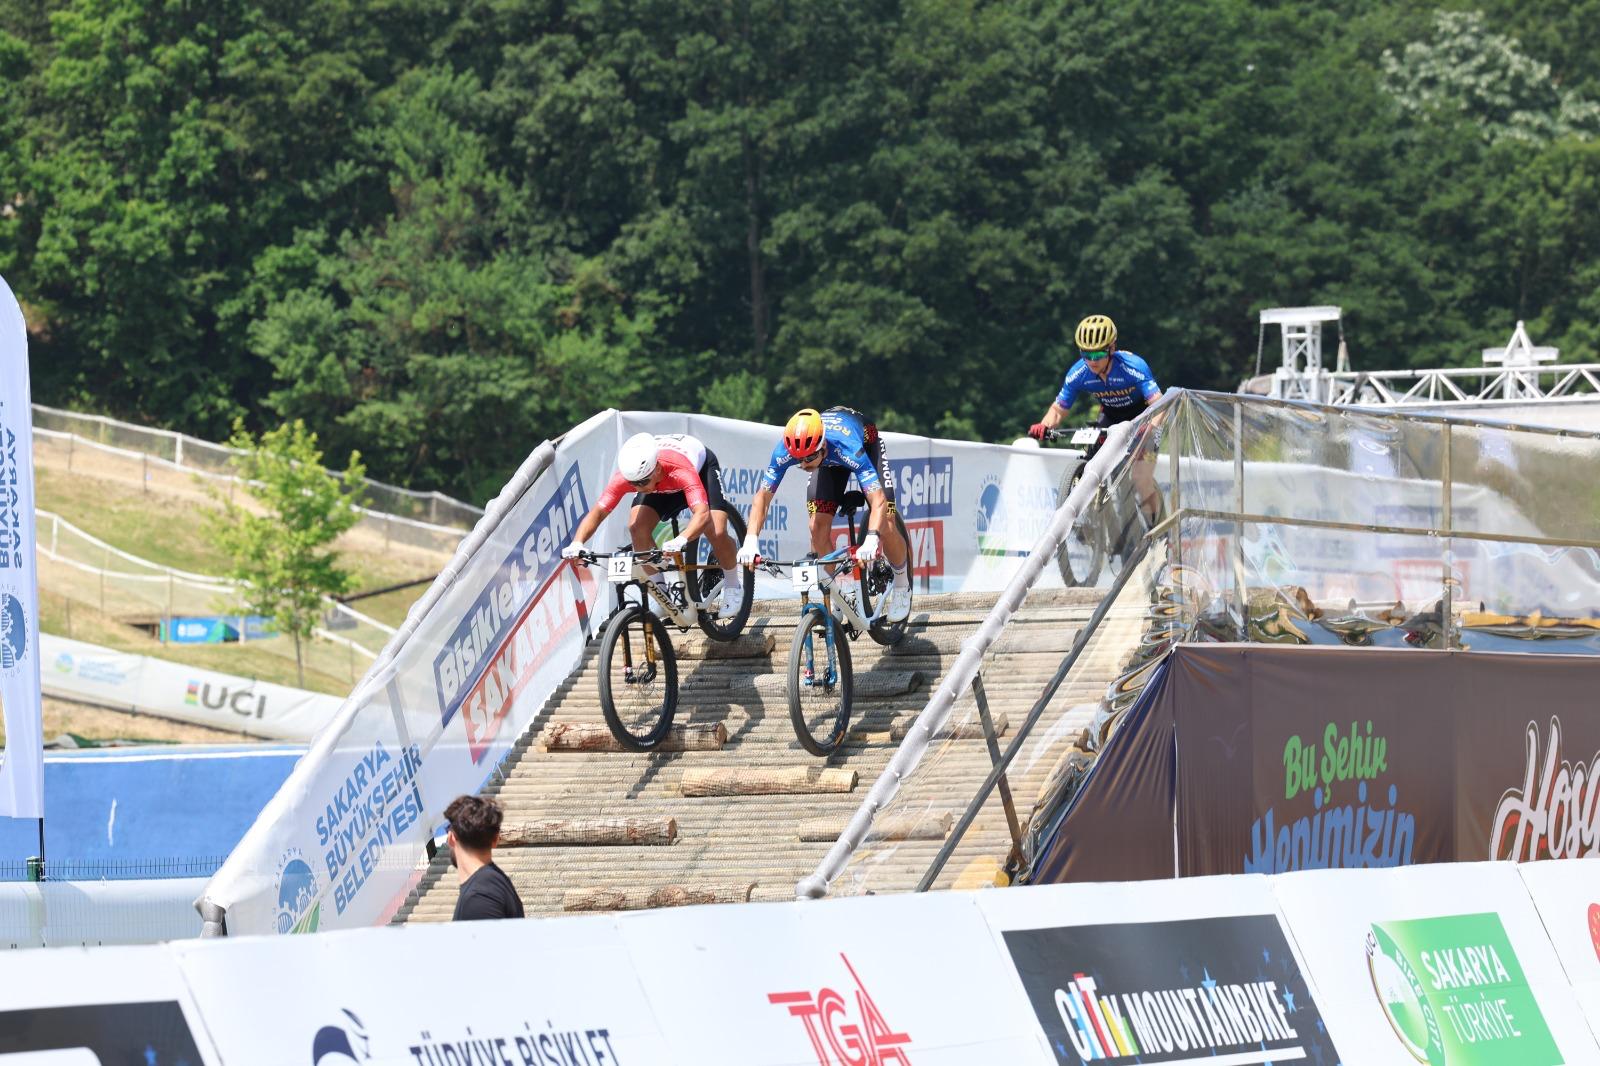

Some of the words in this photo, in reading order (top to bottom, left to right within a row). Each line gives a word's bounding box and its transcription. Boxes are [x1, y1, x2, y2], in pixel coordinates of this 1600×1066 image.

[901, 464, 951, 516] Şehri
[439, 559, 525, 705] Bisiklet
[523, 472, 585, 594] Şehri
[614, 561, 626, 573] 12
[801, 570, 809, 582] 5
[470, 566, 588, 744] SAKARYA
[202, 682, 267, 719] UCI
[315, 740, 391, 846] SAKARYA
[1284, 735, 1317, 799] Bu
[1321, 720, 1387, 804] Şehir
[325, 743, 422, 882] BÜYÜKŞEHİR
[333, 780, 424, 916] BELEDİYESİ
[767, 952, 912, 1066] TGA
[1395, 950, 1424, 997] BIKE
[1422, 1004, 1442, 1053] CITY
[1421, 944, 1511, 990] SAKARYA
[1054, 973, 1139, 1061] CITY
[1122, 981, 1298, 1055] MOUNTAINBIKE
[1442, 992, 1521, 1044] TÜRKİYE
